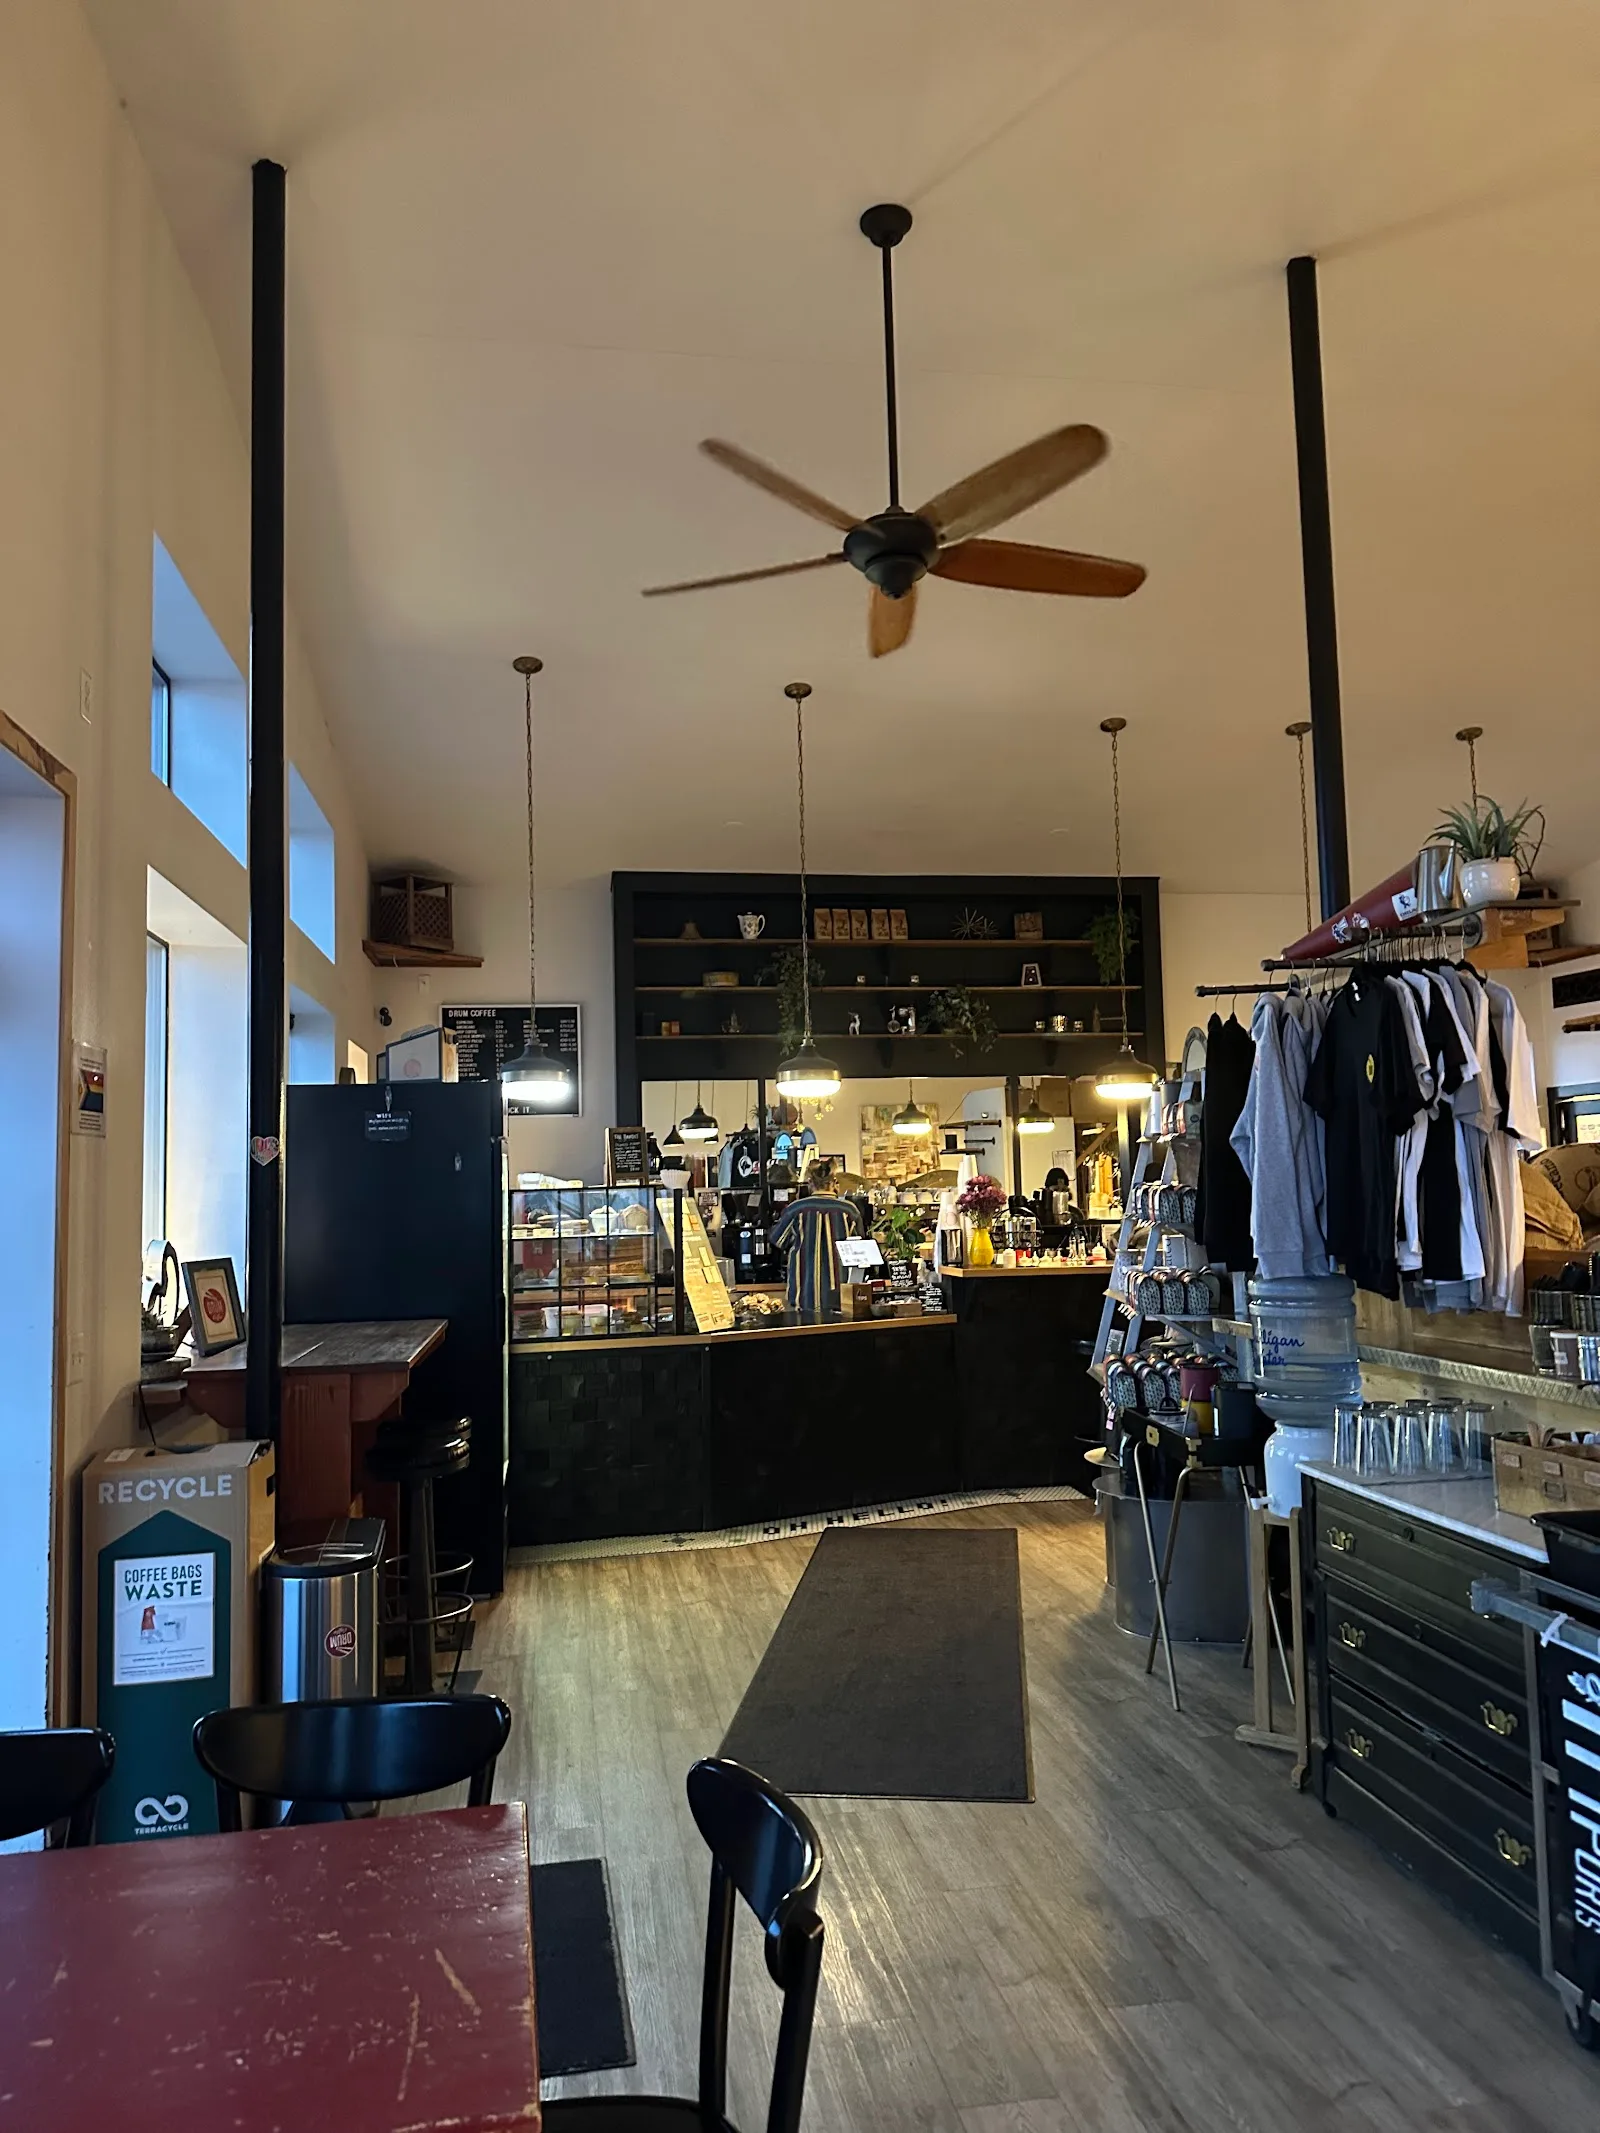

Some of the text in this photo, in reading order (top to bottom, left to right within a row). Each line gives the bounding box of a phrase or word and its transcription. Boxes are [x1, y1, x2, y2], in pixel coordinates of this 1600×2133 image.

[448, 1008, 497, 1018] DRUM COFFEE
[98, 1473, 233, 1504] RECYCLE
[124, 1563, 203, 1584] COFFEE BAGS
[124, 1580, 203, 1602] WASTE
[135, 1822, 189, 1835] TERRACYCLE
